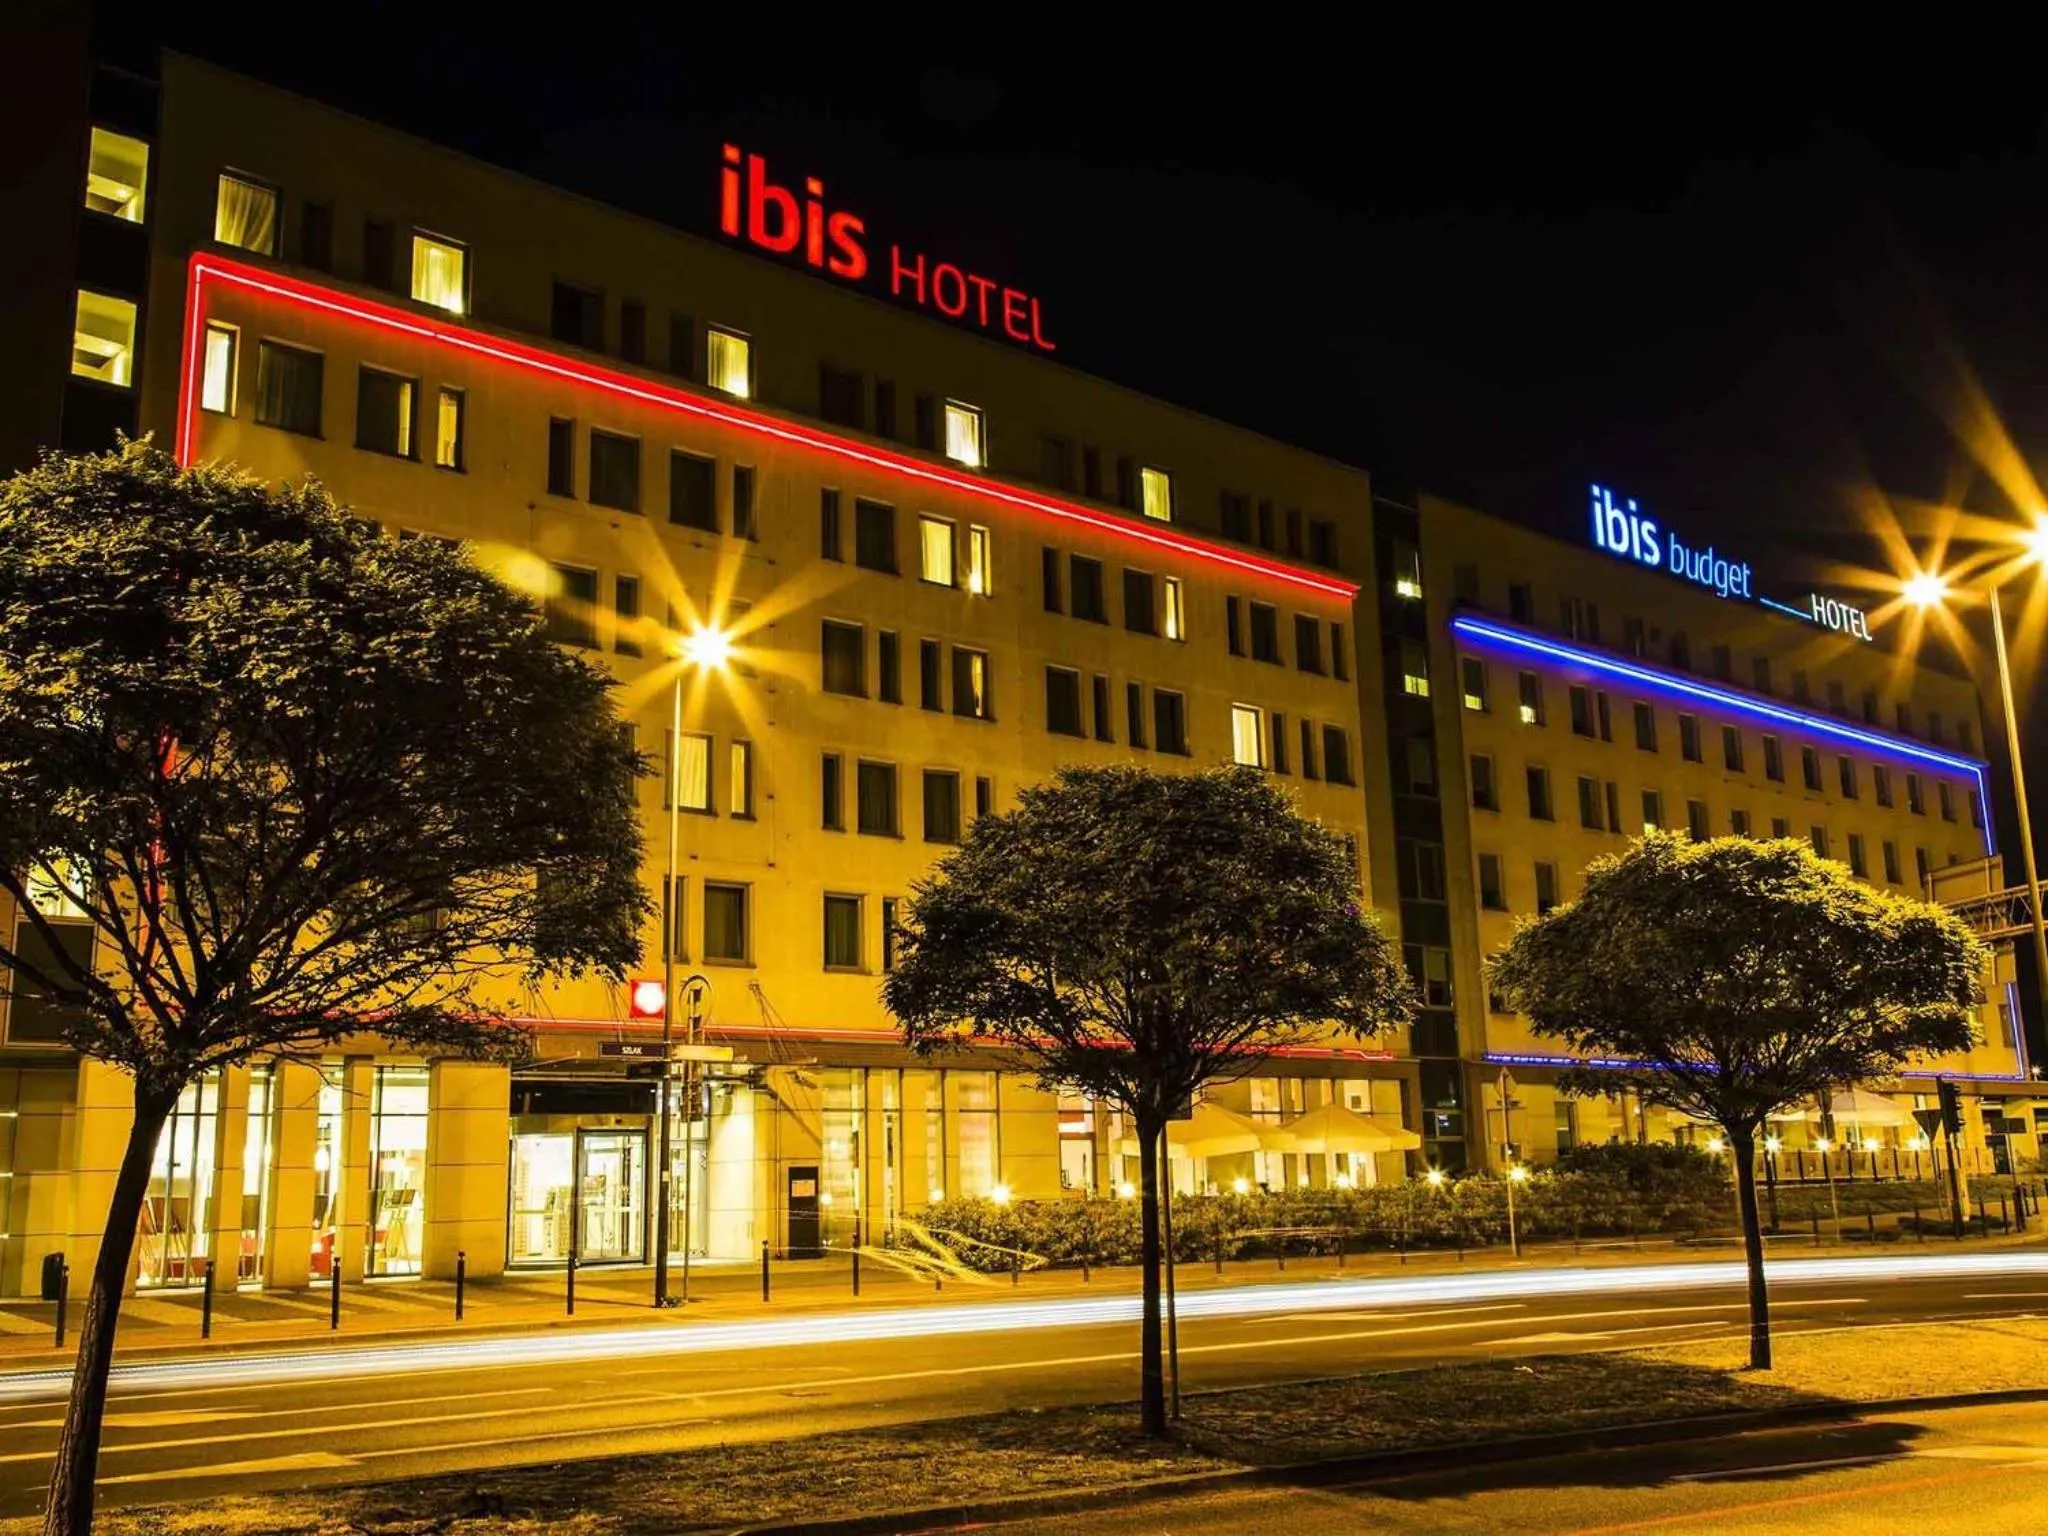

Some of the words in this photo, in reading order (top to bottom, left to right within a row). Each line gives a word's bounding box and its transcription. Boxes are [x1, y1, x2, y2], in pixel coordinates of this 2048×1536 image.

[721, 143, 868, 281] ibis
[891, 244, 1056, 351] HOTEL
[1591, 484, 1661, 566] ibis
[1669, 532, 1751, 599] budget
[1811, 593, 1873, 642] HOTEL
